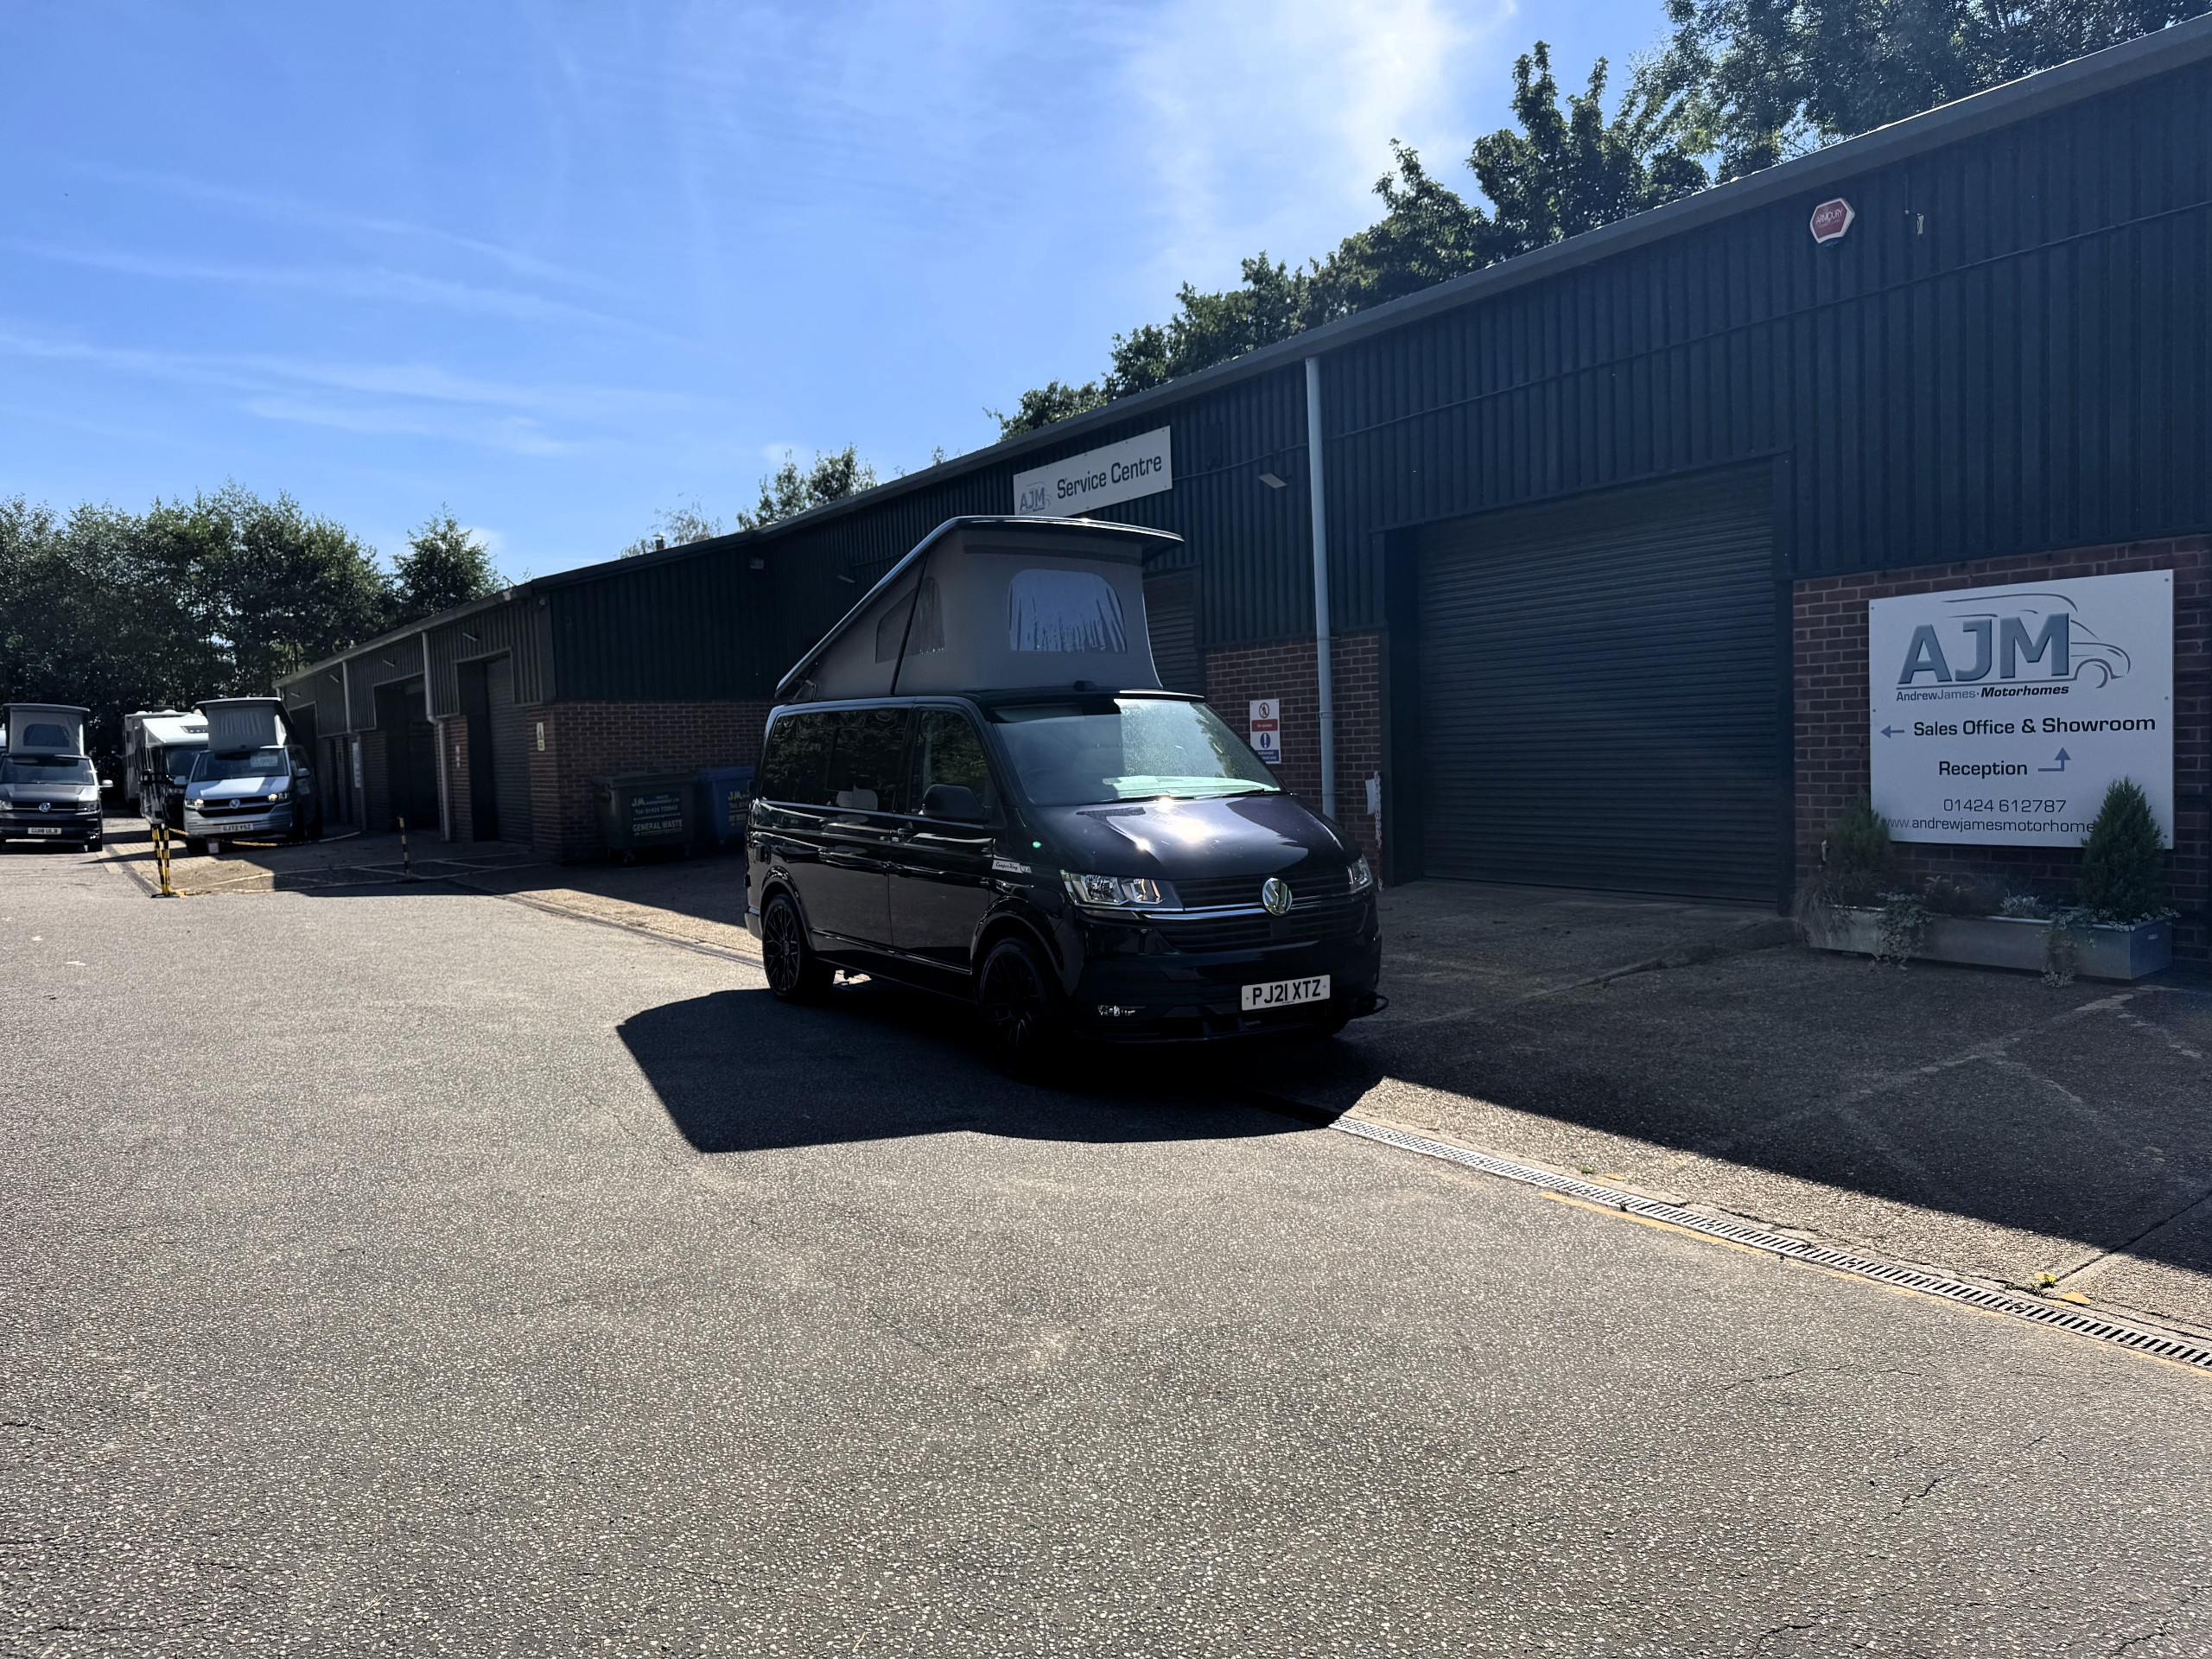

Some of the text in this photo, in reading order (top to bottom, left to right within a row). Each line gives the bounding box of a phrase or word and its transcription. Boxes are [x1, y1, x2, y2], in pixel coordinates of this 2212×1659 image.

[1057, 455, 1162, 499] Service Centre
[1020, 487, 1045, 511] AJM
[1897, 612, 2069, 685] AJM
[1913, 716, 2157, 736] Sales Office & Showroom
[1938, 760, 2028, 779] Reception
[1943, 799, 2067, 813] 01424 612787
[632, 821, 662, 832] GENERAL
[662, 818, 683, 829] WASTE
[1252, 979, 1321, 1006] PJ21 XTZ
